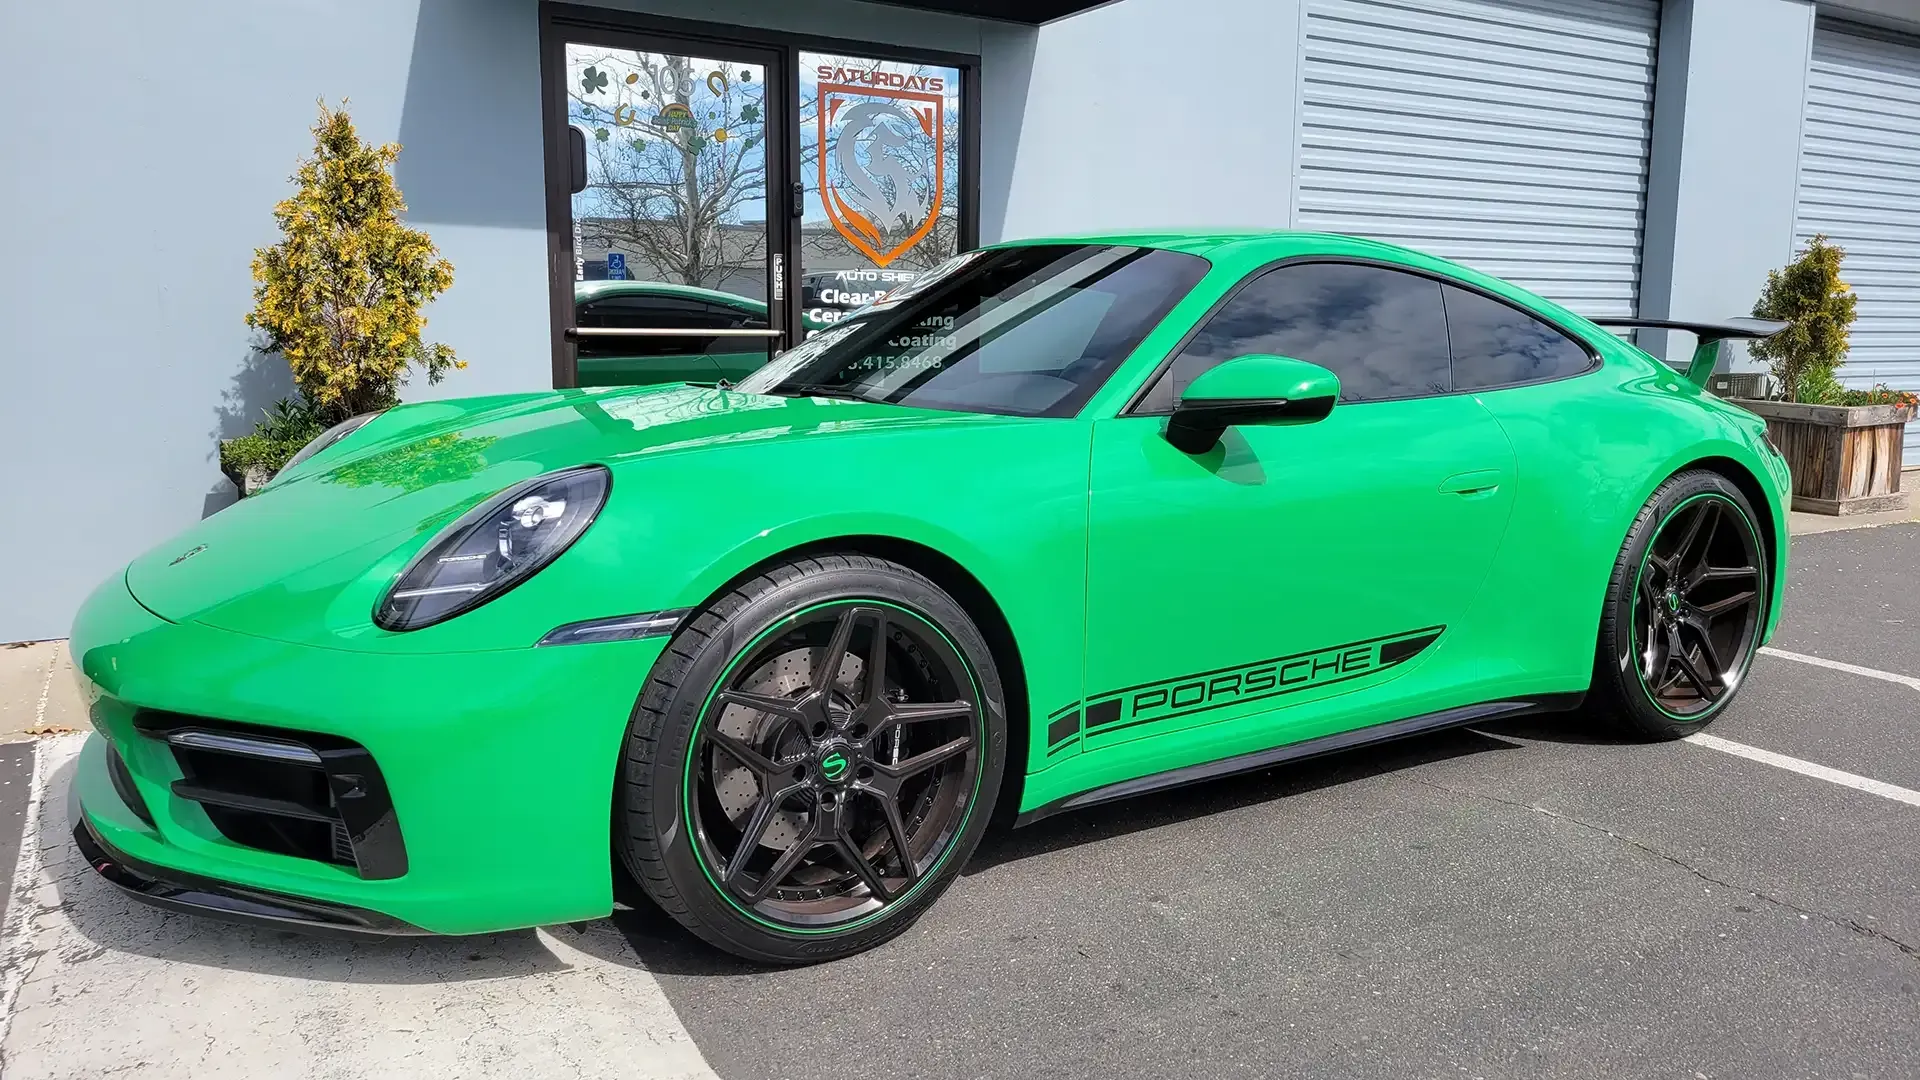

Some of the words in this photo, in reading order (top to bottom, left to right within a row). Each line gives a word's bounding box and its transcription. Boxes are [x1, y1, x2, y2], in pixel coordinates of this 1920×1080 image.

[649, 64, 696, 97] 105
[817, 65, 944, 92] SATURDAYS
[574, 215, 582, 234] Dro
[576, 257, 585, 281] Early
[775, 257, 783, 289] PUSH
[835, 271, 878, 281] AUTO
[881, 272, 915, 282] SHIE
[1132, 646, 1373, 718] PORSCHE
